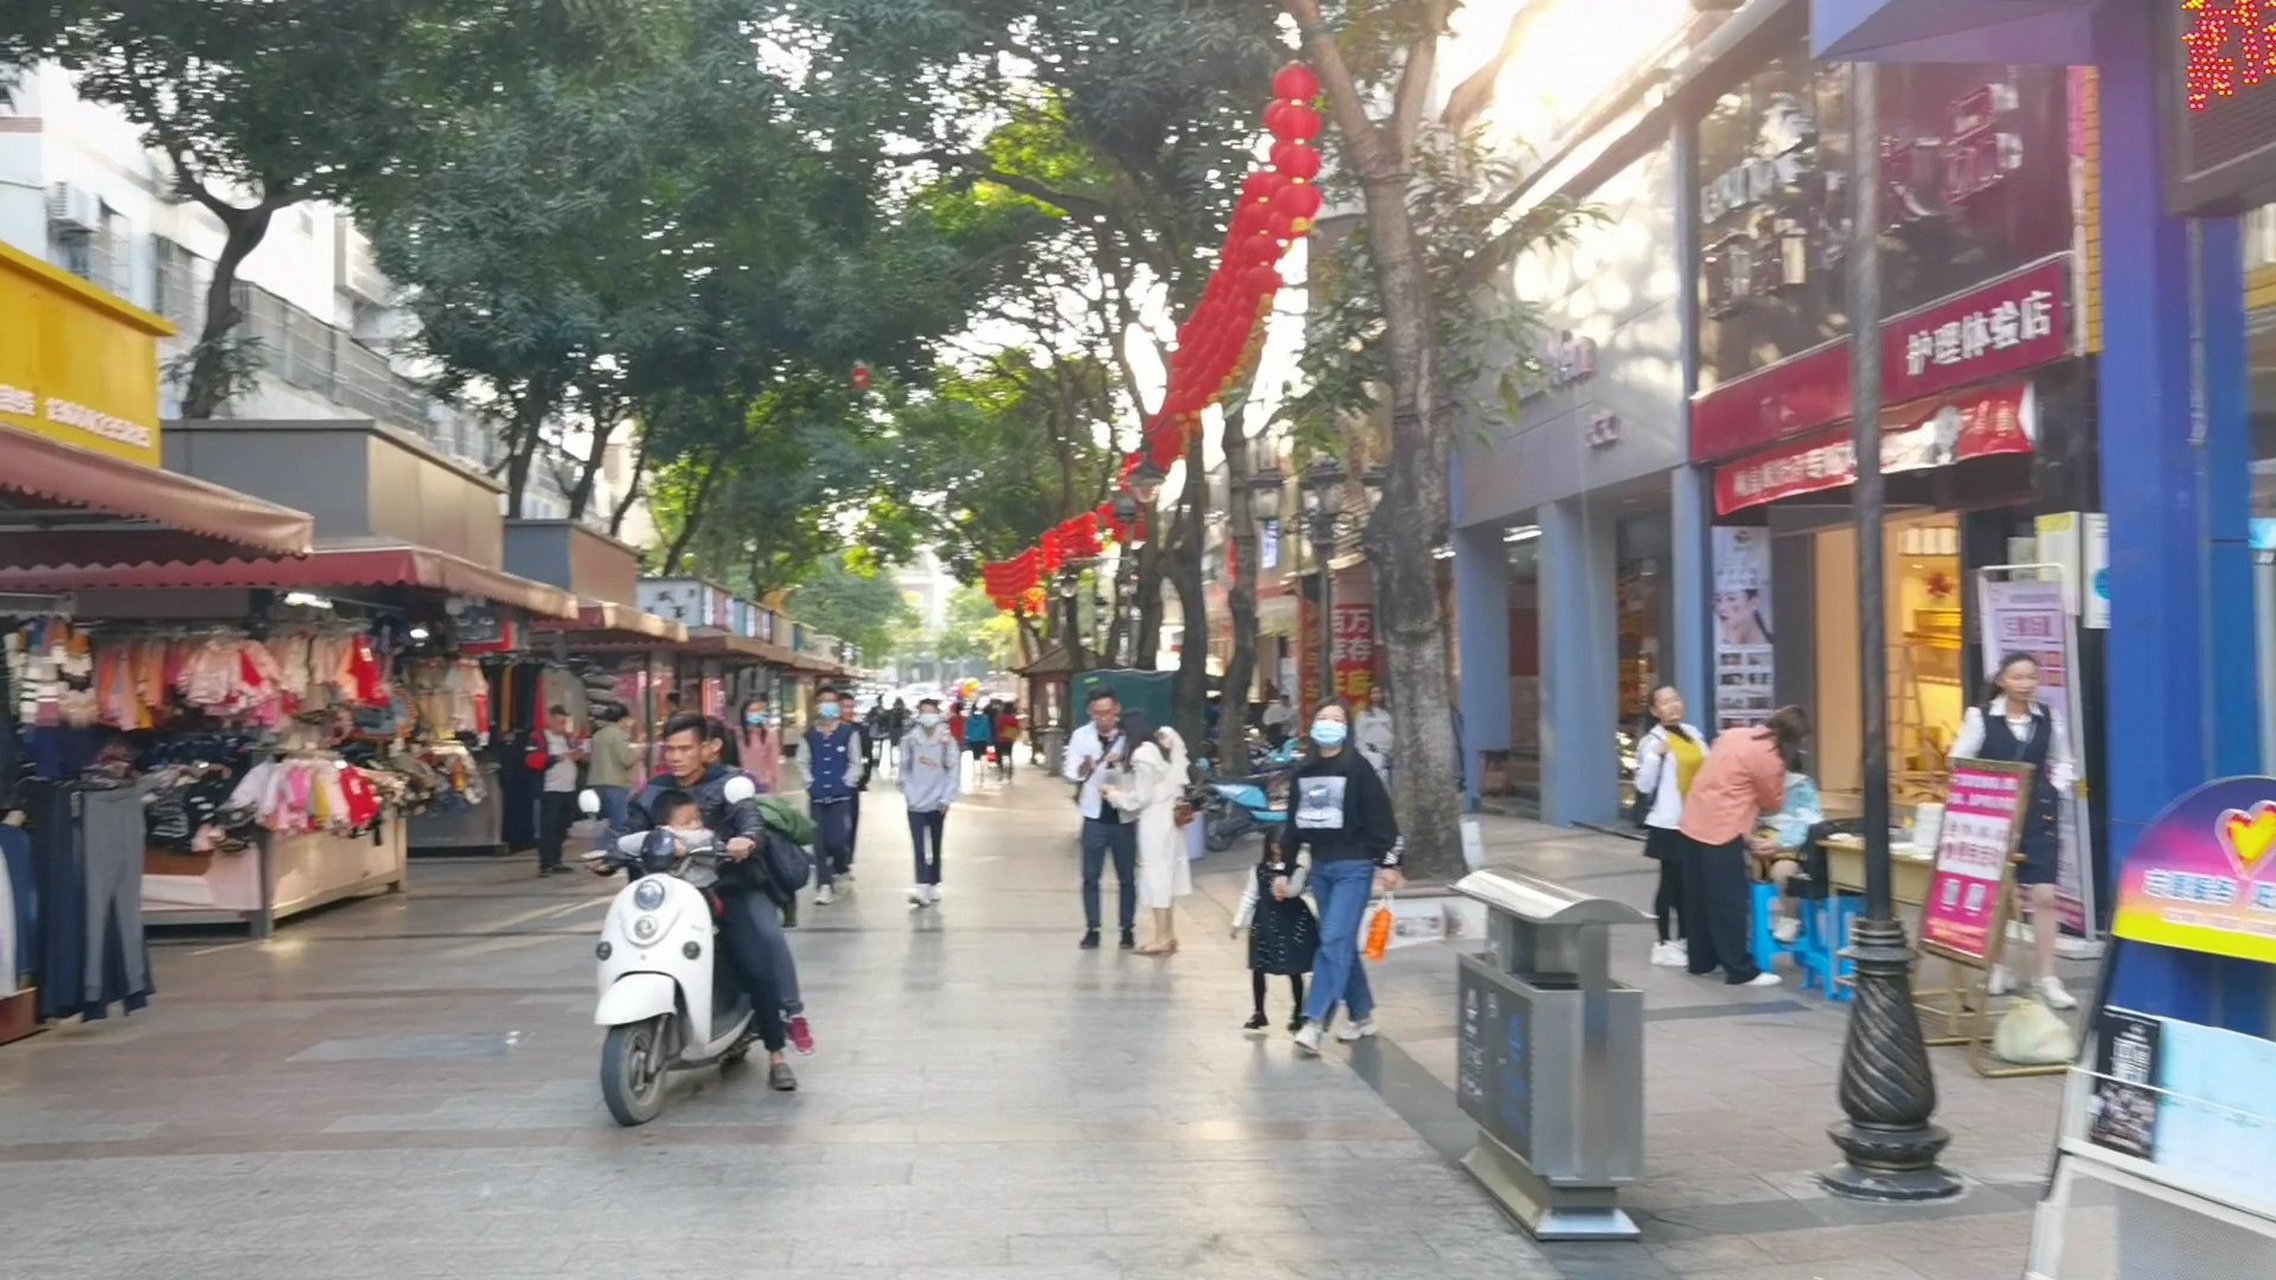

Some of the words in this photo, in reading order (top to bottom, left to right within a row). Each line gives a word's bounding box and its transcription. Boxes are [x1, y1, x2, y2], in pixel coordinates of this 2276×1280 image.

[1906, 290, 2053, 376] 护理体验店
